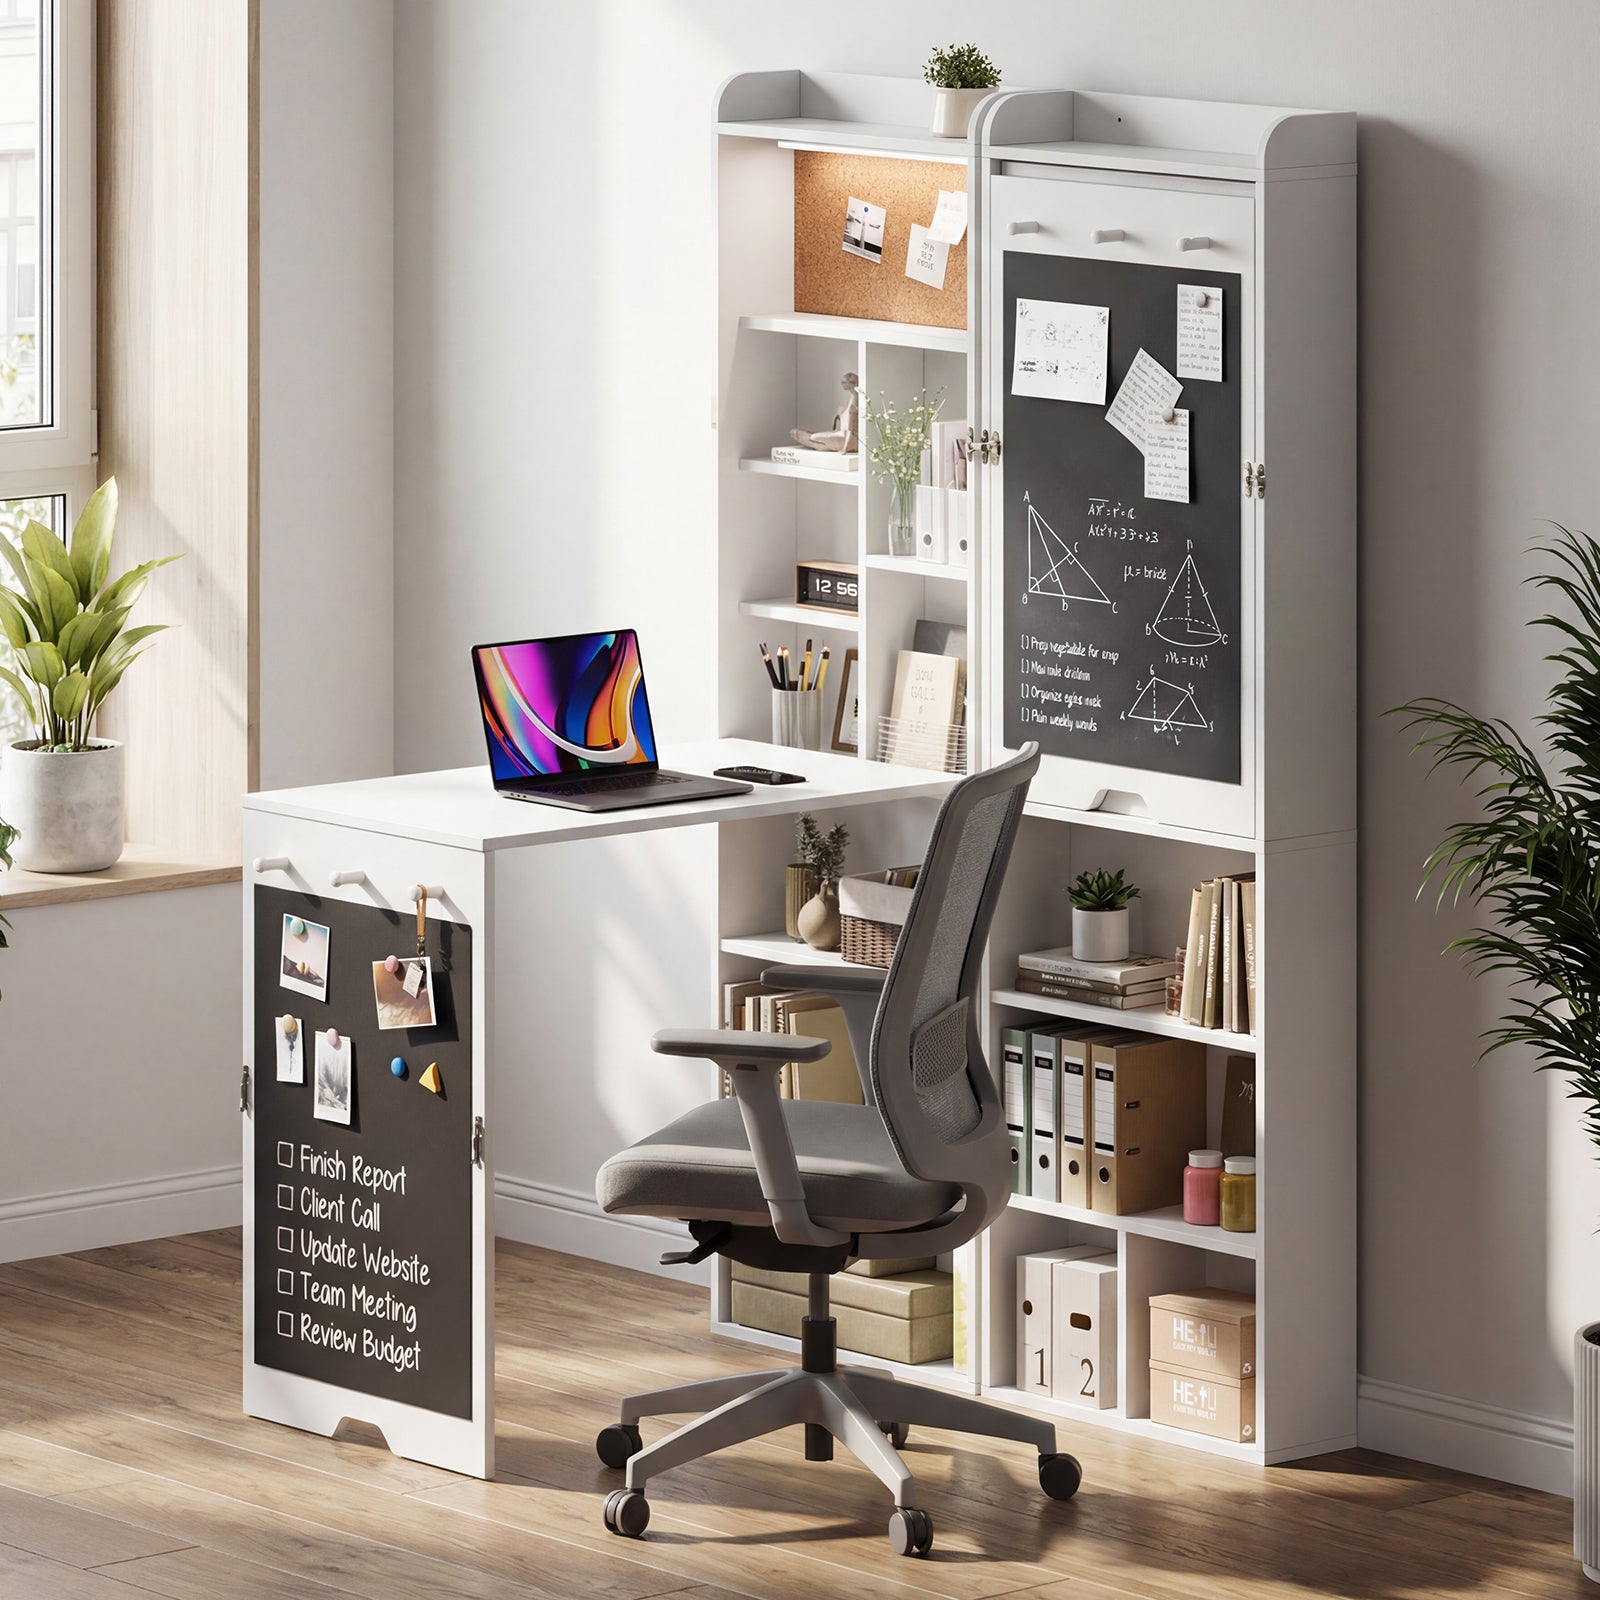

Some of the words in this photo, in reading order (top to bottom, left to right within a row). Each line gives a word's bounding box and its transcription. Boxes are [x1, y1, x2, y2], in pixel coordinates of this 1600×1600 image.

[815, 578, 832, 594] 12
[836, 581, 858, 597] 56
[300, 1143, 347, 1181] Finish
[352, 1154, 407, 1196] Report
[300, 1185, 346, 1224] Client
[351, 1196, 381, 1233] Call
[300, 1228, 358, 1269] Update
[362, 1242, 432, 1287] Website
[300, 1270, 346, 1309] Team
[351, 1283, 417, 1333] Meeting
[300, 1312, 357, 1354] Review
[362, 1328, 422, 1373] Budget
[1034, 1347, 1049, 1388] 1
[1079, 1357, 1096, 1398] 2
